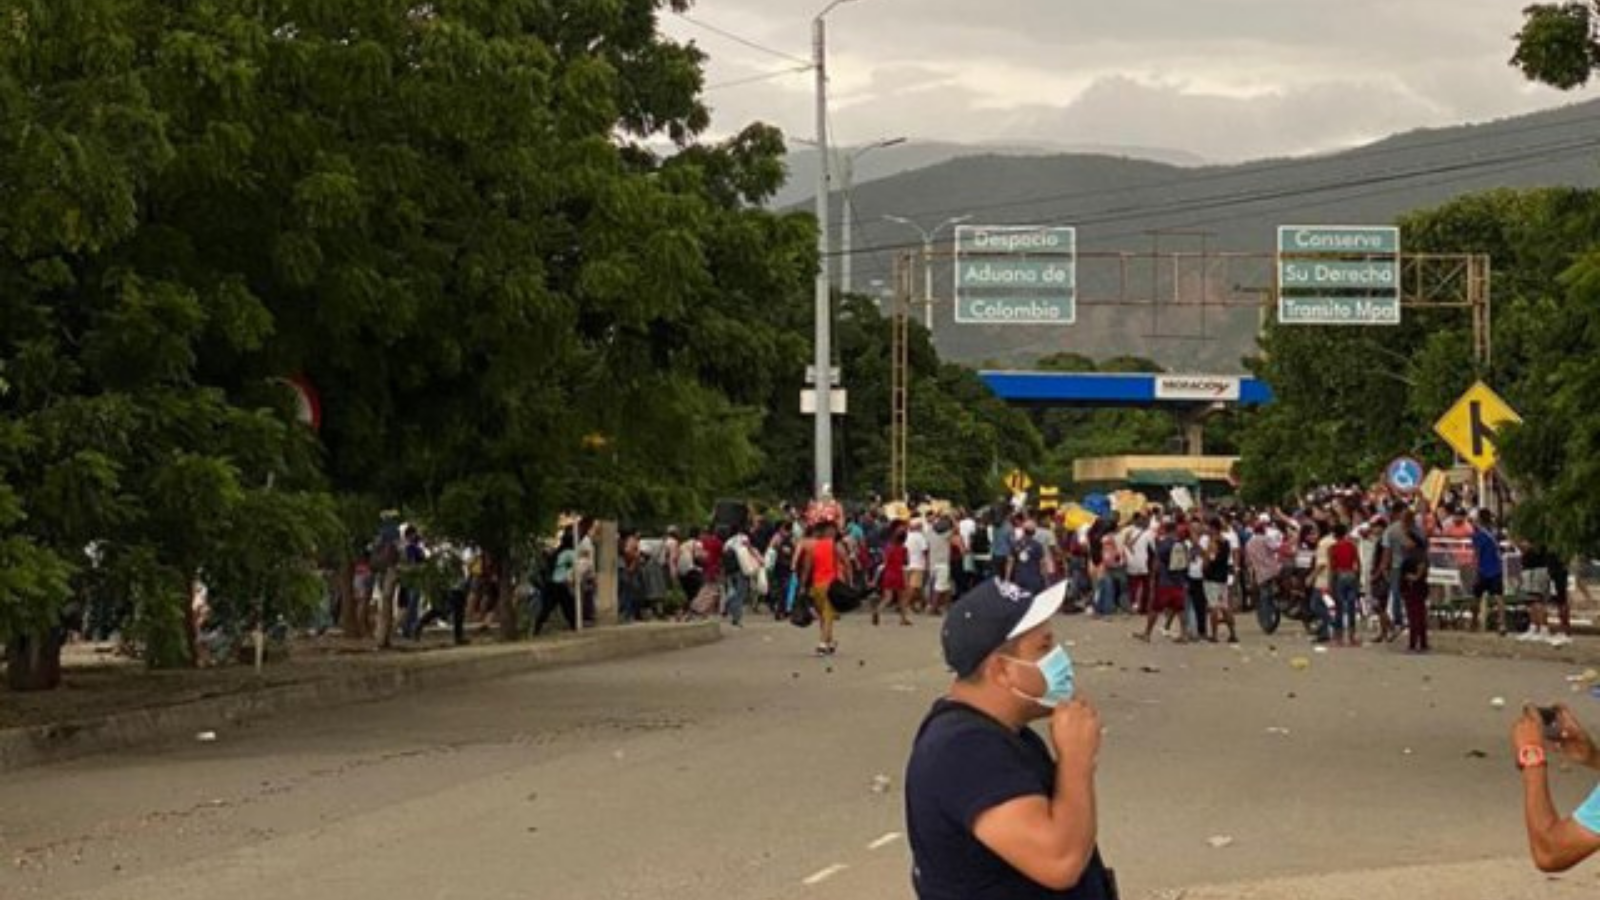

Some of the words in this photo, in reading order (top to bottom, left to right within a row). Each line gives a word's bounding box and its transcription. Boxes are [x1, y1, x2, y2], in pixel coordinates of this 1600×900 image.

[973, 231, 1058, 251] Despacio
[964, 263, 1037, 281] Aduana
[1042, 263, 1066, 282] de
[1286, 264, 1308, 281] Su
[969, 299, 1061, 318] Colombia
